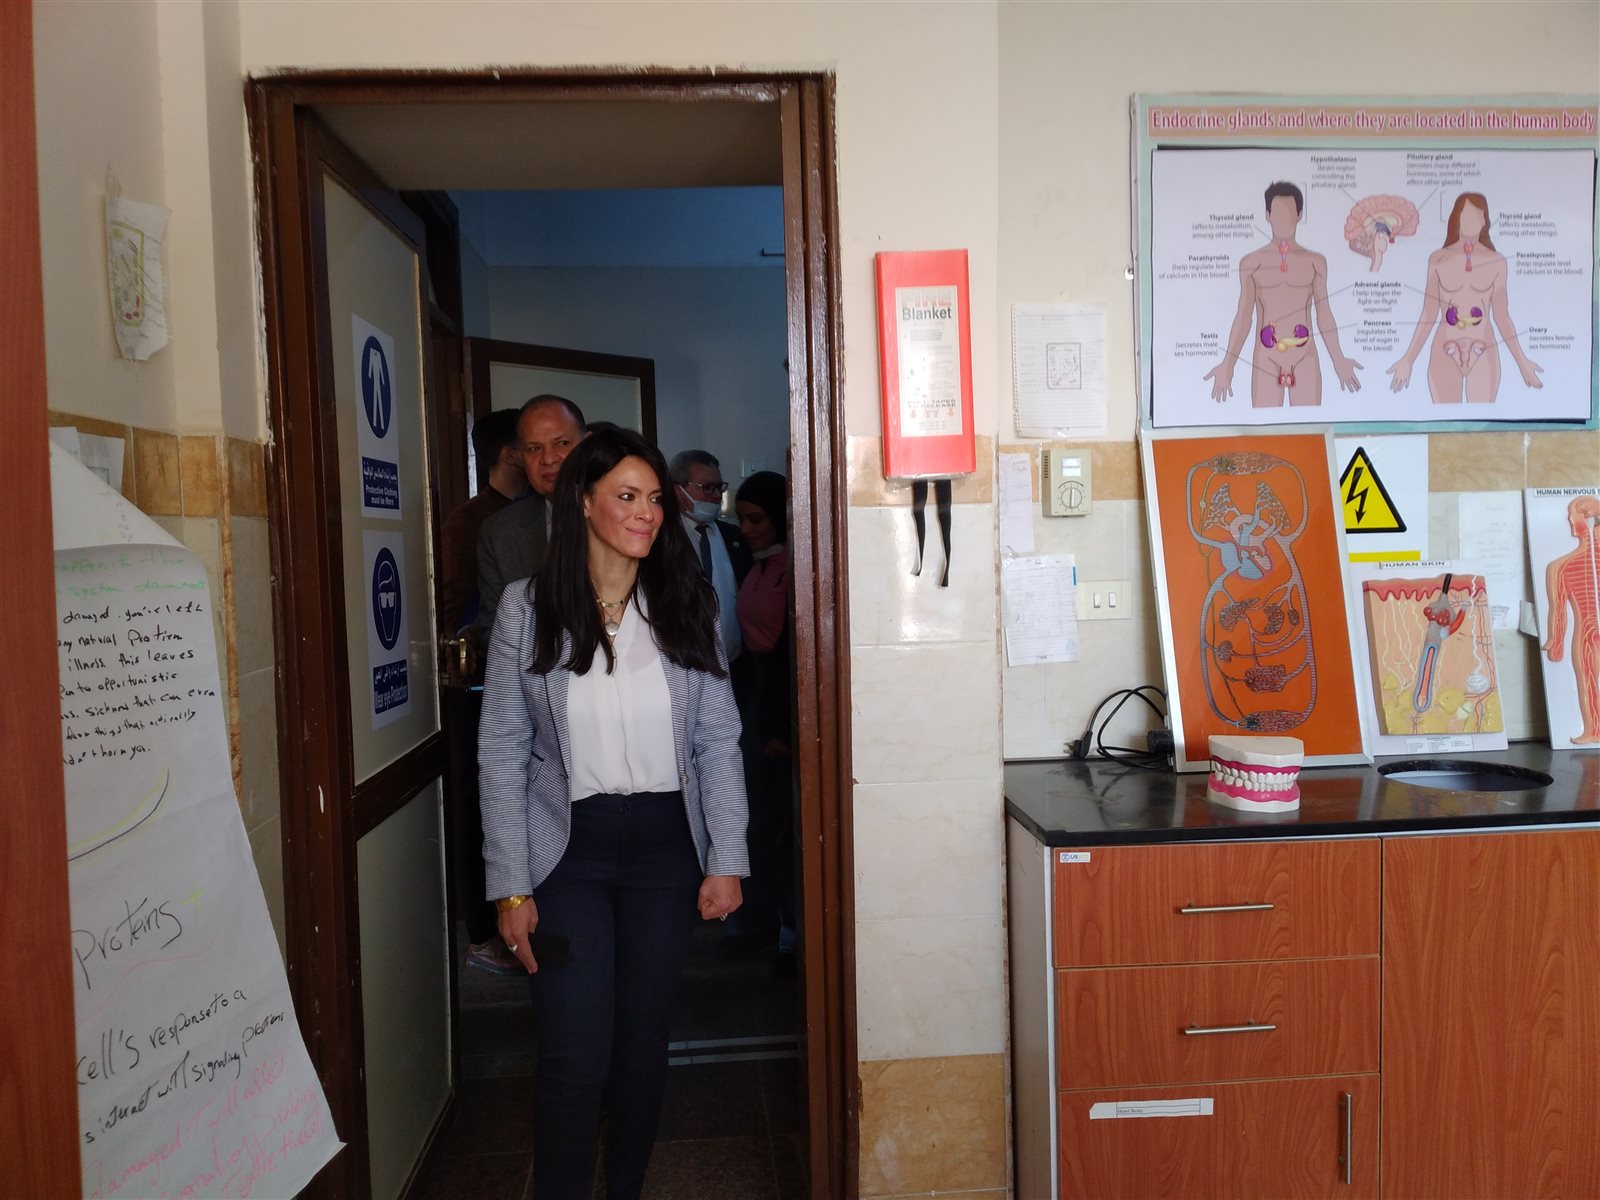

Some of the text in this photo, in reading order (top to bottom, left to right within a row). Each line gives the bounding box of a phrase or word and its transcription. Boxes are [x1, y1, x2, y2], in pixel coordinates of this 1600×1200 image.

[1152, 109, 1595, 132] Endocrine glands and where they are located in the human body
[1310, 156, 1357, 164] Hypothalamus
[1209, 213, 1254, 222] Thyroid gland
[1500, 212, 1542, 220] Thyroid gland
[1188, 254, 1230, 262] Parathyroids
[1189, 263, 1215, 271] regulate
[1209, 271, 1230, 279] blood)
[902, 306, 952, 320] Blanket
[1529, 326, 1548, 334] Ovary
[366, 484, 398, 499] Protective Clothing
[1536, 488, 1562, 496] HUMAN
[78, 634, 116, 646] natural
[119, 653, 140, 668] this
[148, 650, 194, 662] leaves
[98, 672, 178, 692] opportunistic
[70, 897, 182, 990] Proteins
[150, 1008, 211, 1049] response
[233, 989, 248, 1000] a
